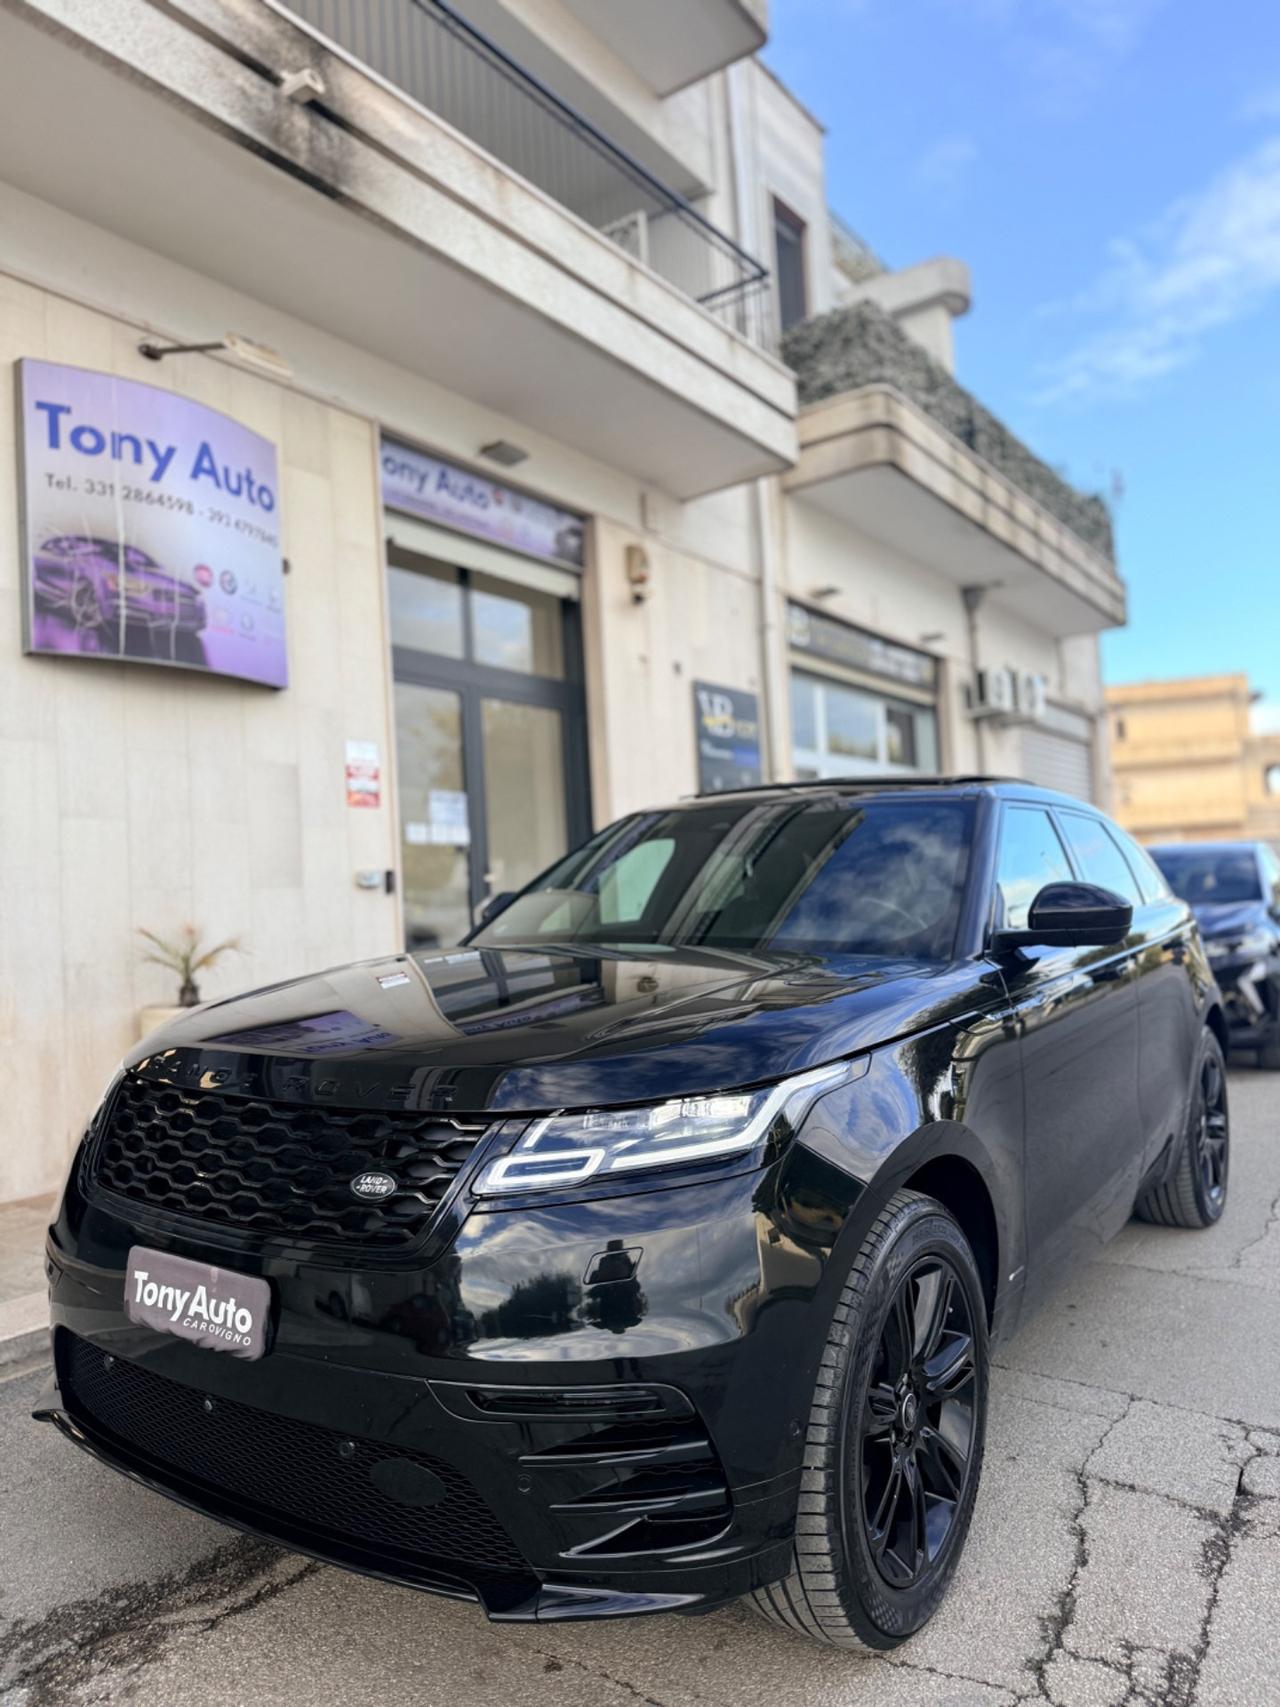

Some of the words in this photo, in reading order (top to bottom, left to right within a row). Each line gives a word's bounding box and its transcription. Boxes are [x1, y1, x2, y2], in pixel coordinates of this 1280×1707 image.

[35, 400, 177, 482] Tony
[190, 441, 275, 512] Auto
[46, 473, 79, 492] Tel.
[84, 477, 116, 498] 331
[382, 455, 428, 493] ony
[436, 468, 490, 511] Auto
[359, 1183, 388, 1194] ROVER
[183, 1317, 252, 1346] CAROVIGNO
